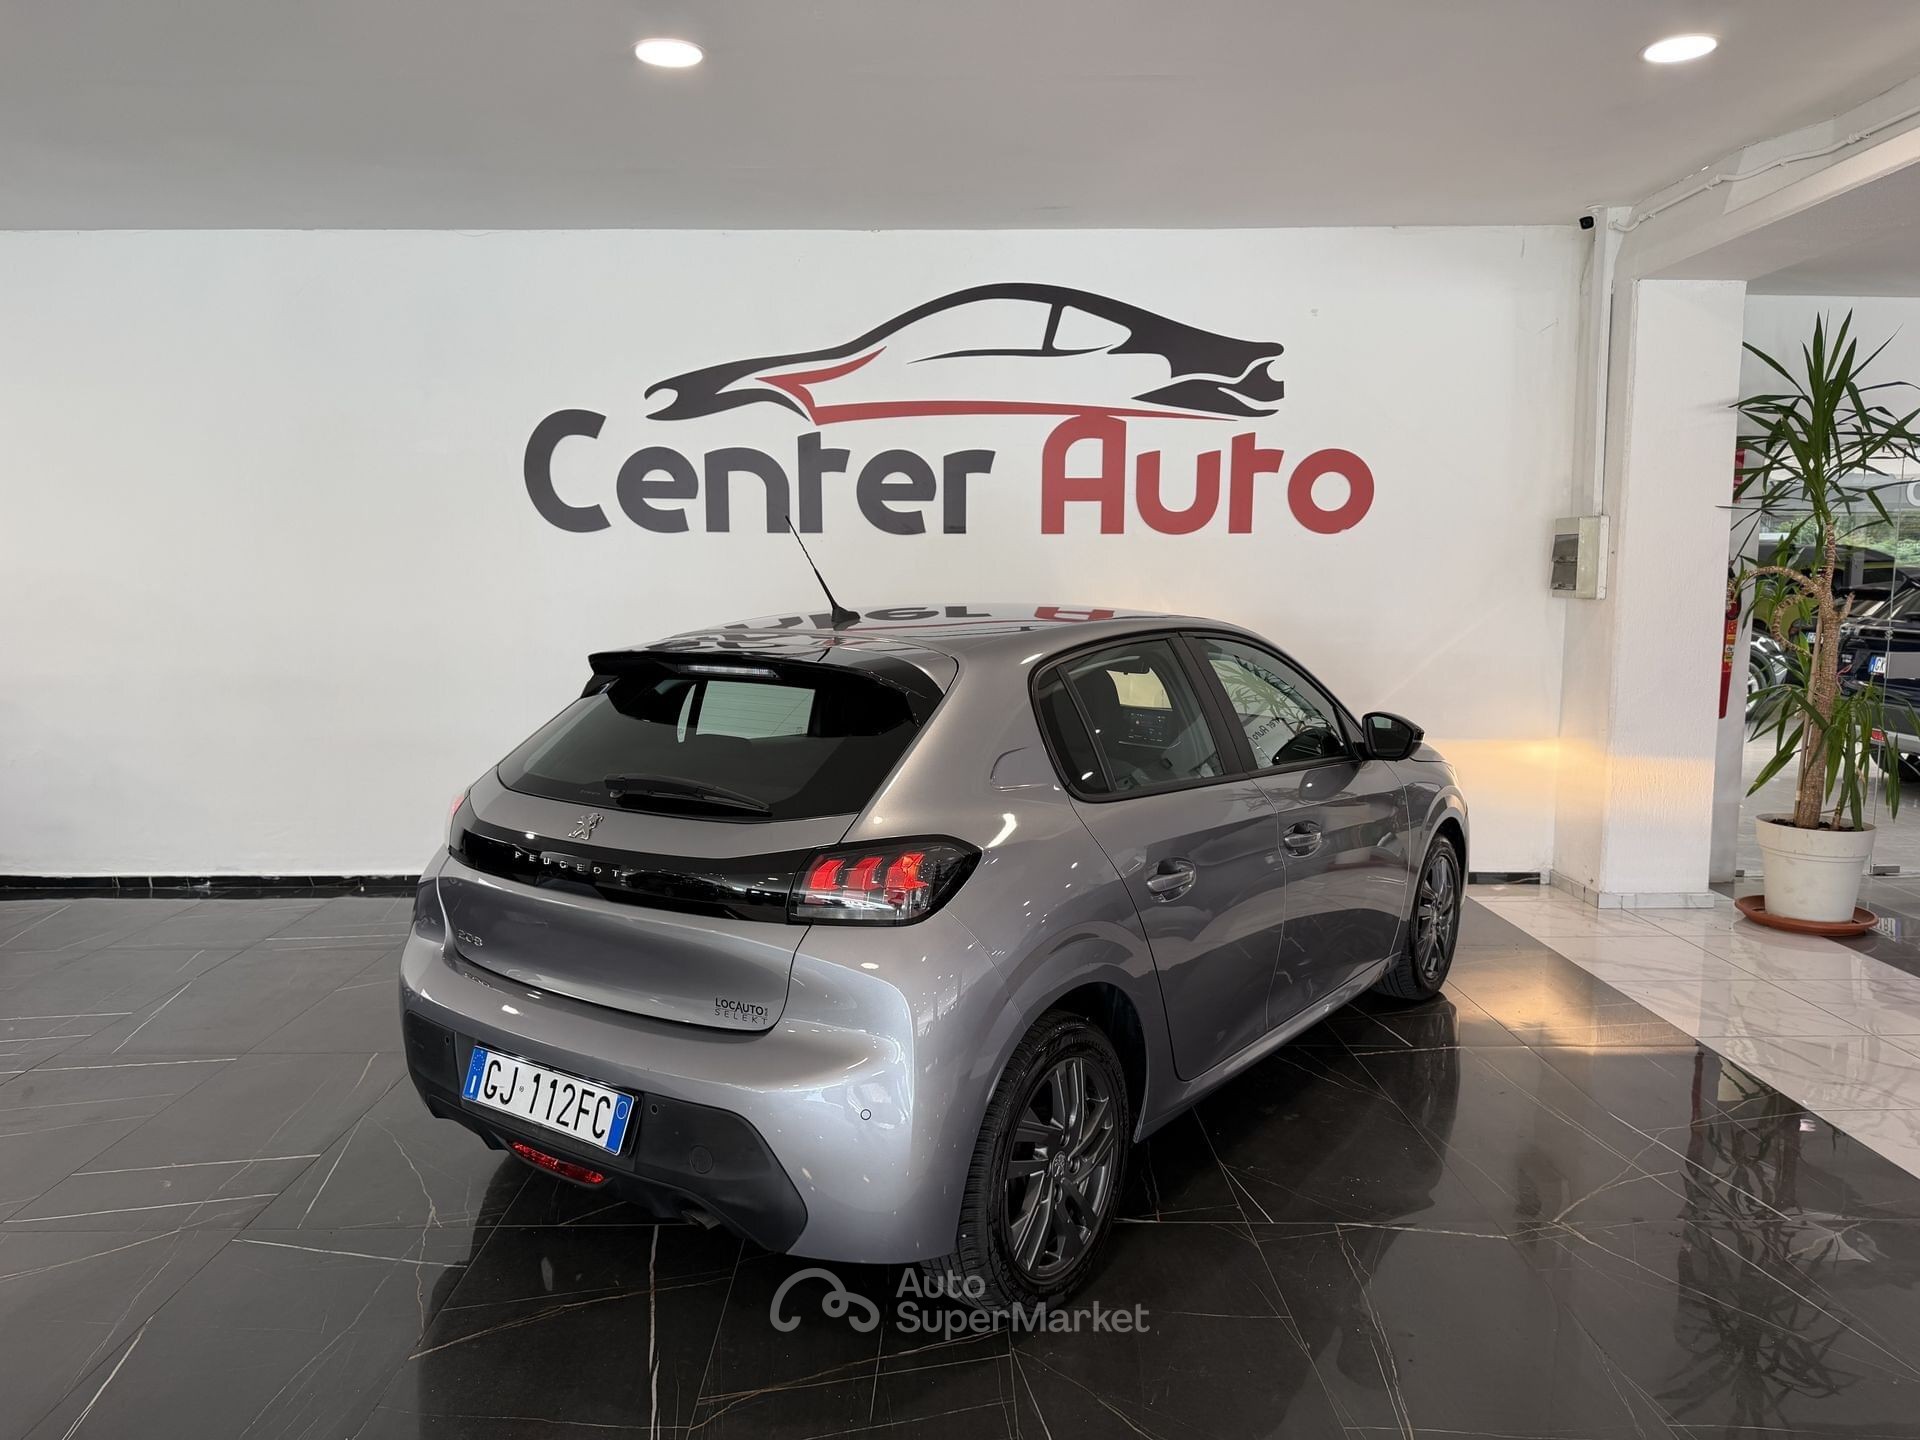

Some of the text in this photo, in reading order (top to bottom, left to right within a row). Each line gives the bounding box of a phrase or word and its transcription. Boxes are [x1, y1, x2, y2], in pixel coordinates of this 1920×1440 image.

[524, 408, 1374, 535] Center Auto
[514, 851, 620, 878] PEUGEOT
[458, 929, 483, 947] 208
[715, 997, 764, 1015] LOCAUTO
[714, 1008, 768, 1024] SELEKT
